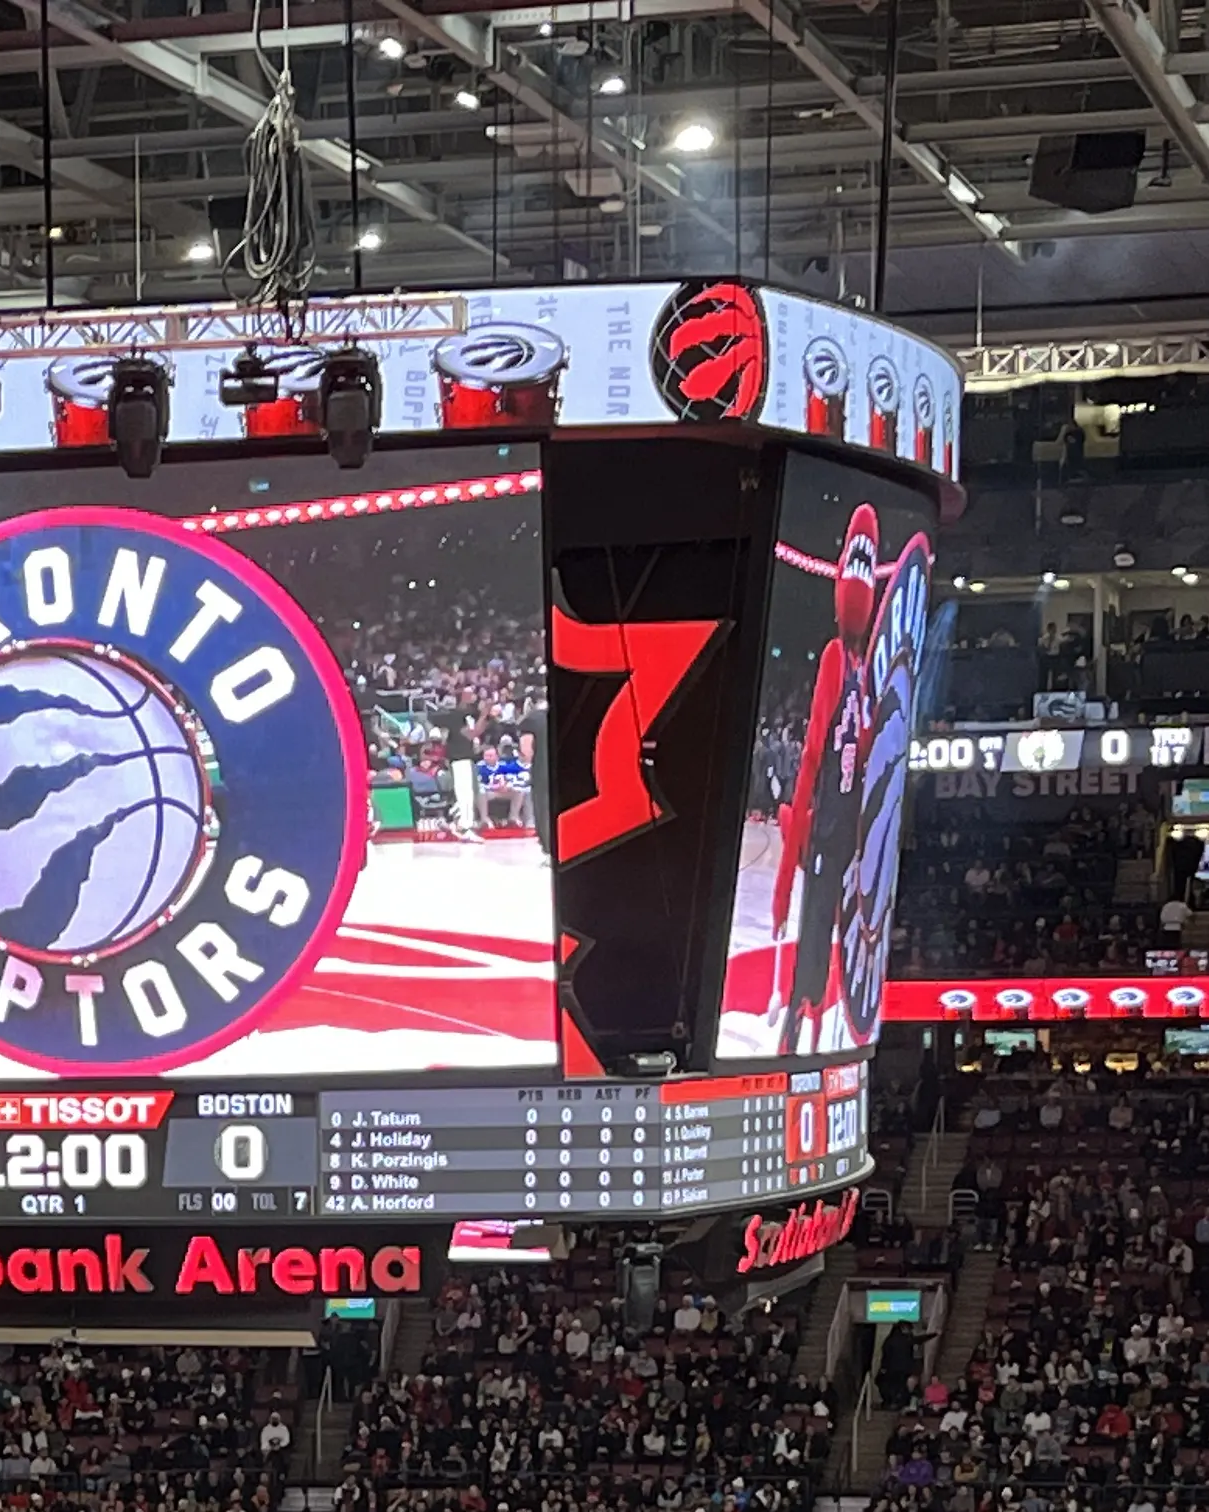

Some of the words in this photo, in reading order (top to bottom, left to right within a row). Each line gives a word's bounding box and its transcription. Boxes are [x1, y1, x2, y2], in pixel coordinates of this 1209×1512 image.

[934, 771, 1002, 799] BAY
[1011, 766, 1143, 797] STREET
[198, 1093, 292, 1116] BOSTON
[518, 1088, 544, 1102] PTS
[595, 1088, 622, 1101] AST
[634, 1087, 651, 1100] PF
[22, 1096, 157, 1123] TISSOT
[331, 1112, 342, 1127] 0
[352, 1111, 368, 1127] J.
[371, 1111, 421, 1127] Tatum
[330, 1133, 341, 1149] 4
[351, 1132, 366, 1149] J.
[370, 1132, 431, 1149] Holiday
[220, 1124, 265, 1180] 0
[351, 1152, 368, 1169] K.
[372, 1152, 449, 1172] Porzingis
[330, 1174, 341, 1190] 9
[351, 1173, 368, 1190] D.
[372, 1173, 420, 1190] White
[21, 1194, 65, 1215] QTR
[74, 1195, 85, 1213] 1
[178, 1193, 203, 1211] FLS
[211, 1193, 236, 1211] 00
[251, 1193, 279, 1211] TOL
[294, 1192, 308, 1211] 7
[325, 1194, 345, 1211] 42
[351, 1193, 369, 1211] A.
[372, 1193, 435, 1211] Horford
[175, 1236, 421, 1293] Arena
